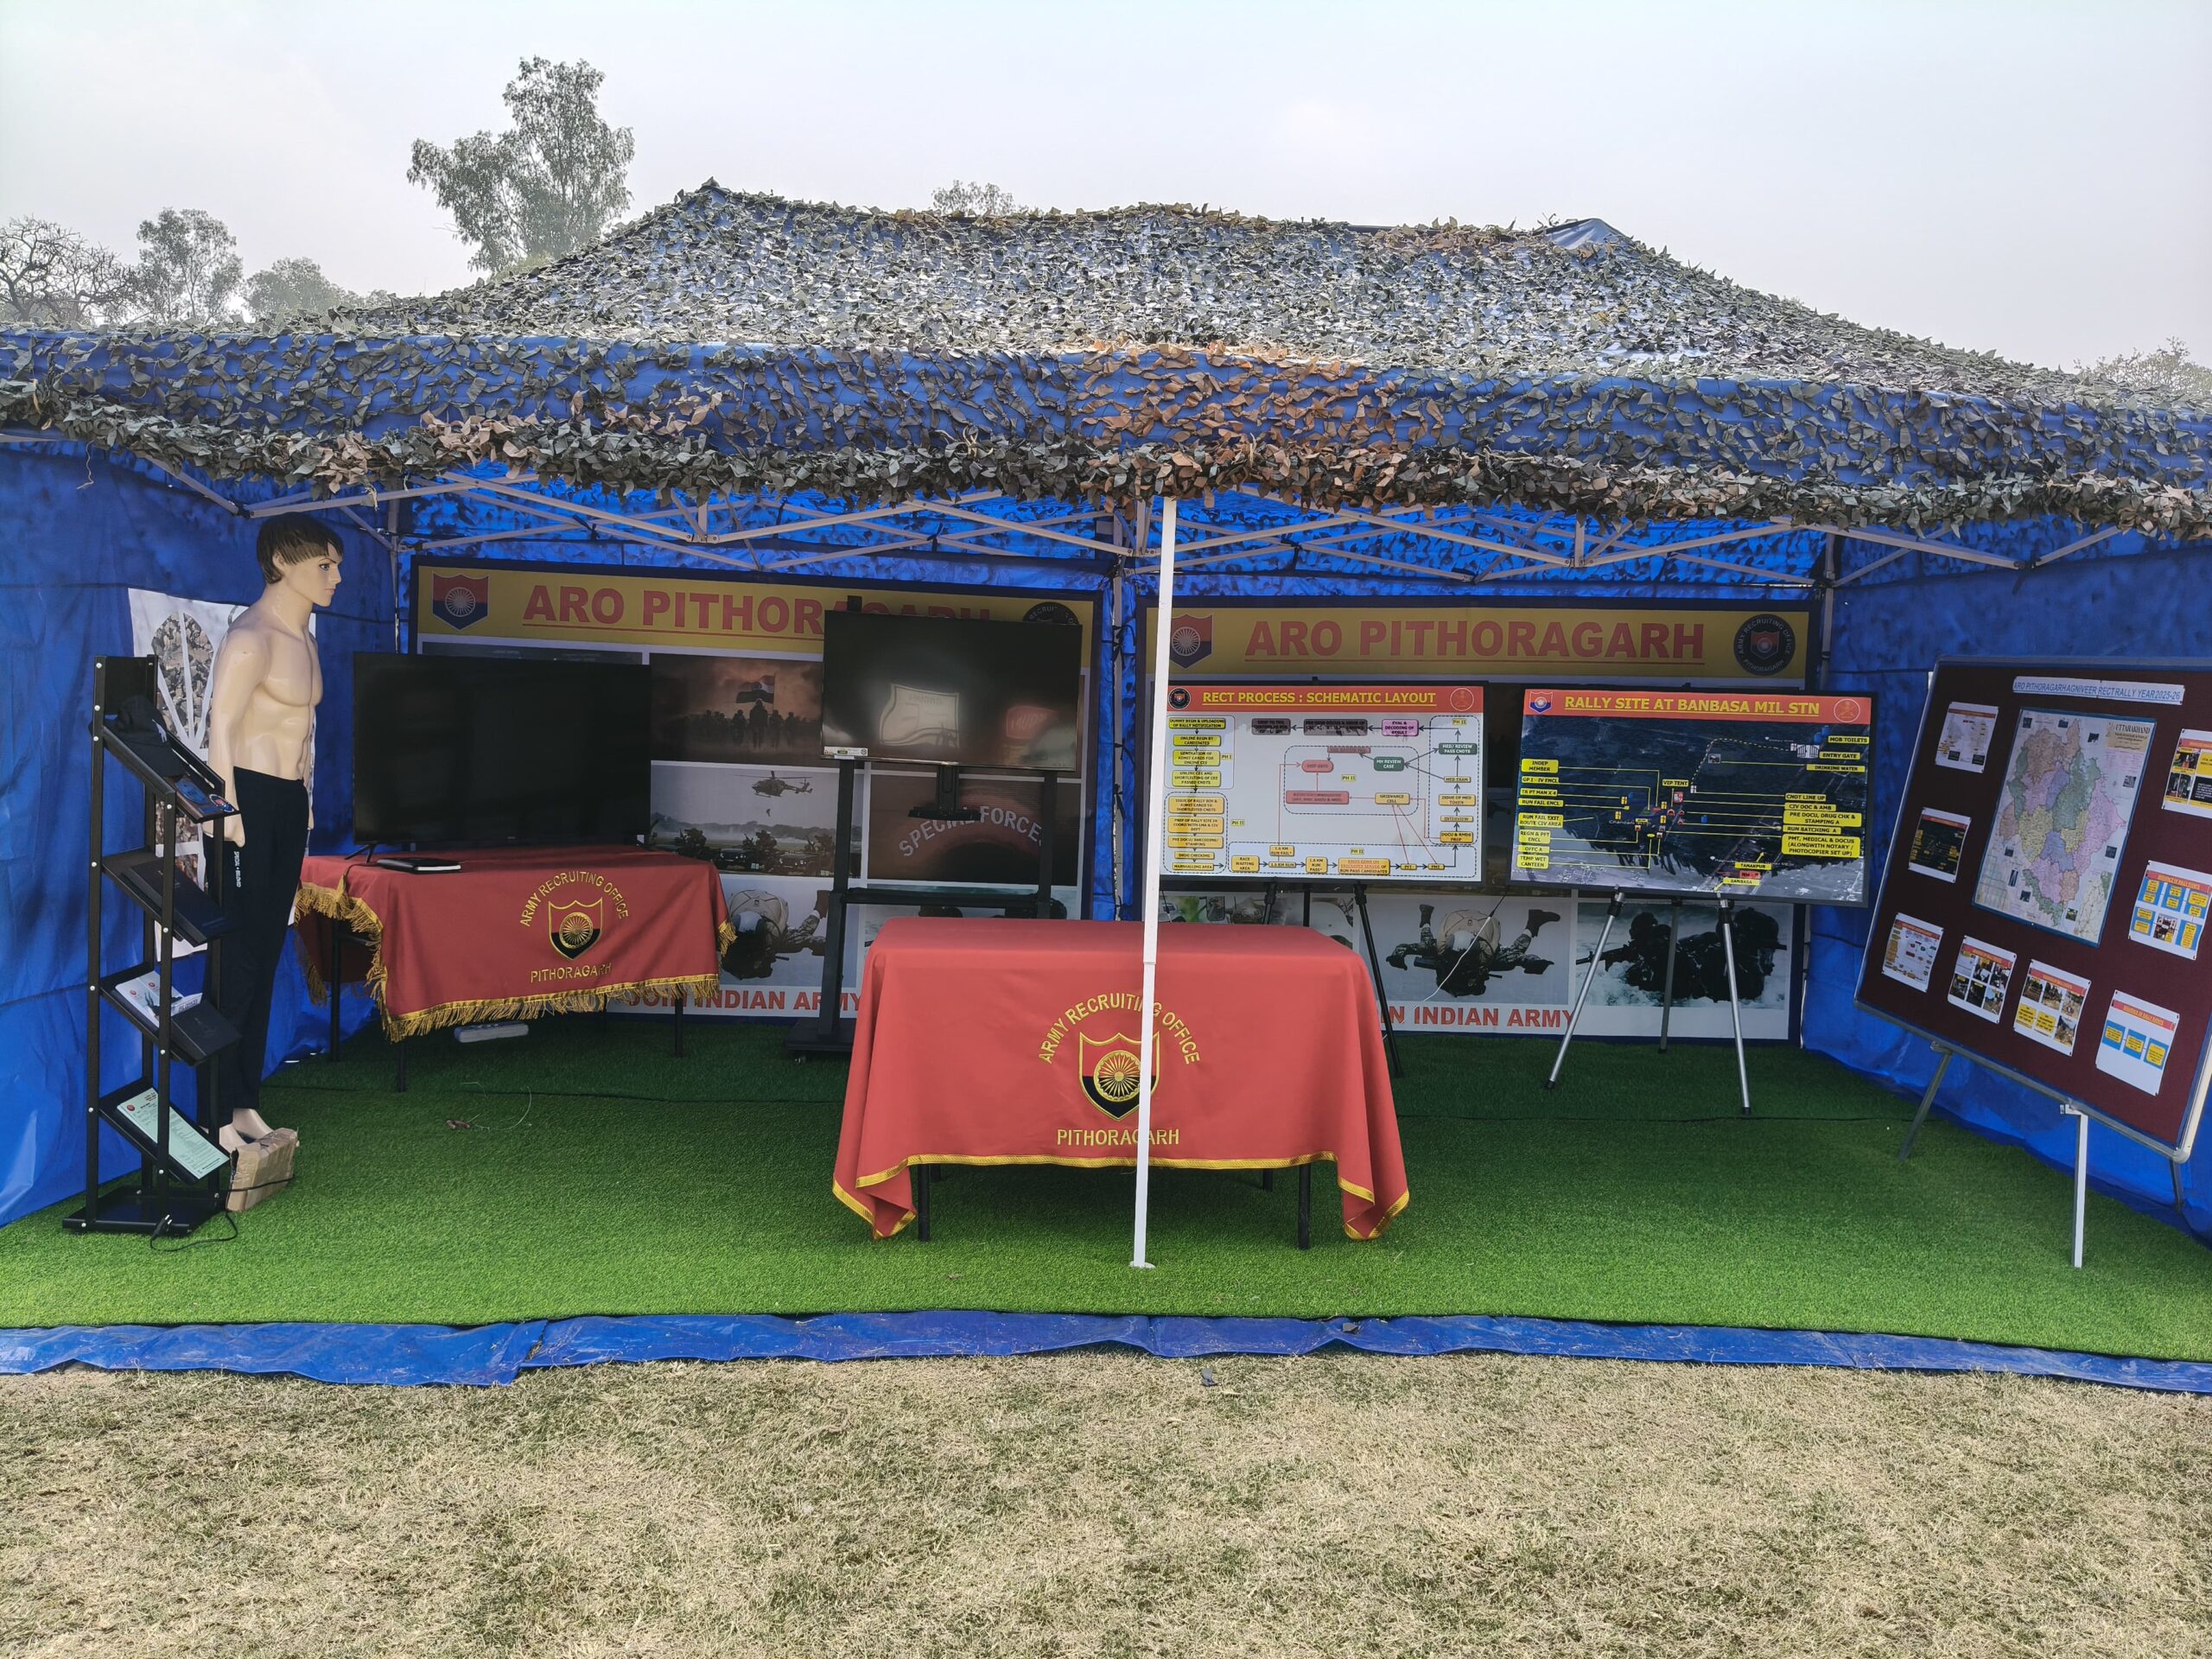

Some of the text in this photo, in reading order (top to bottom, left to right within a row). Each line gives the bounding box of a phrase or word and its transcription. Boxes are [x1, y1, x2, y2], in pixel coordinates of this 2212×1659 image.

[523, 585, 991, 634] ARO PITHOR
[1245, 620, 1704, 658] ARO PITHORAGARH
[1203, 692, 1236, 703] RECT
[1238, 692, 1296, 703] PROCESS
[1306, 692, 1382, 703] SCHEMATIC
[1385, 693, 1436, 703] LAYOUT
[1565, 696, 1820, 715] RALLY SITE AT BANBASA MIL STN
[980, 805, 1042, 847] FORCE
[520, 870, 629, 926] ARMY RECRUITING OFFICE
[531, 963, 612, 983] PITHORAGARH
[1039, 993, 1200, 1065] ARMY RECRUITIG OFFICE
[1414, 1006, 1499, 1027] INDIAN
